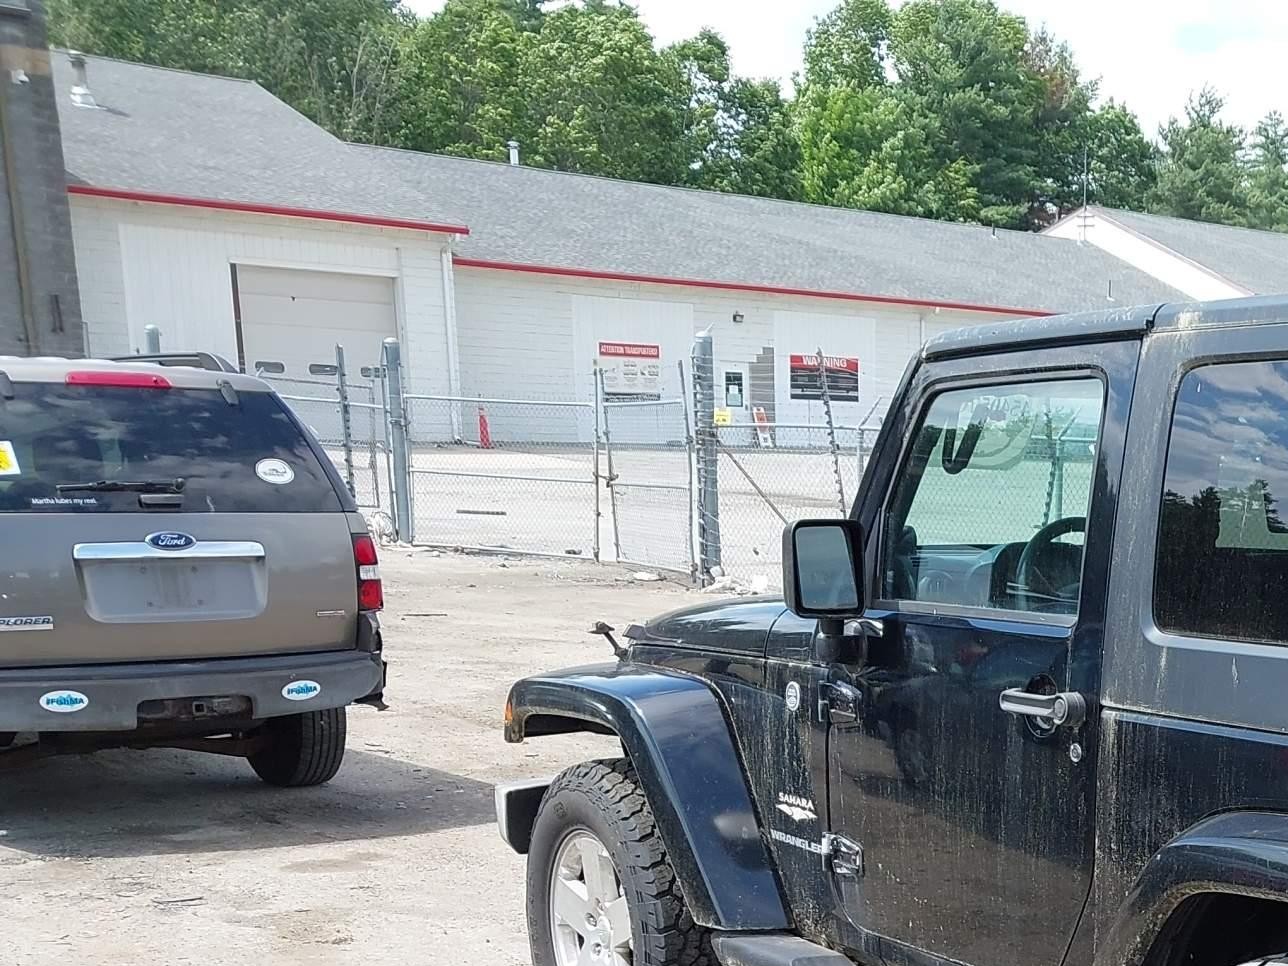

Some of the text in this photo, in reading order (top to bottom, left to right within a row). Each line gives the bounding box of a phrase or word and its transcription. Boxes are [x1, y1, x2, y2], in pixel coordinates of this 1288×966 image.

[802, 356, 847, 368] WANING
[158, 534, 186, 545] Ford
[778, 791, 816, 811] SAHARA
